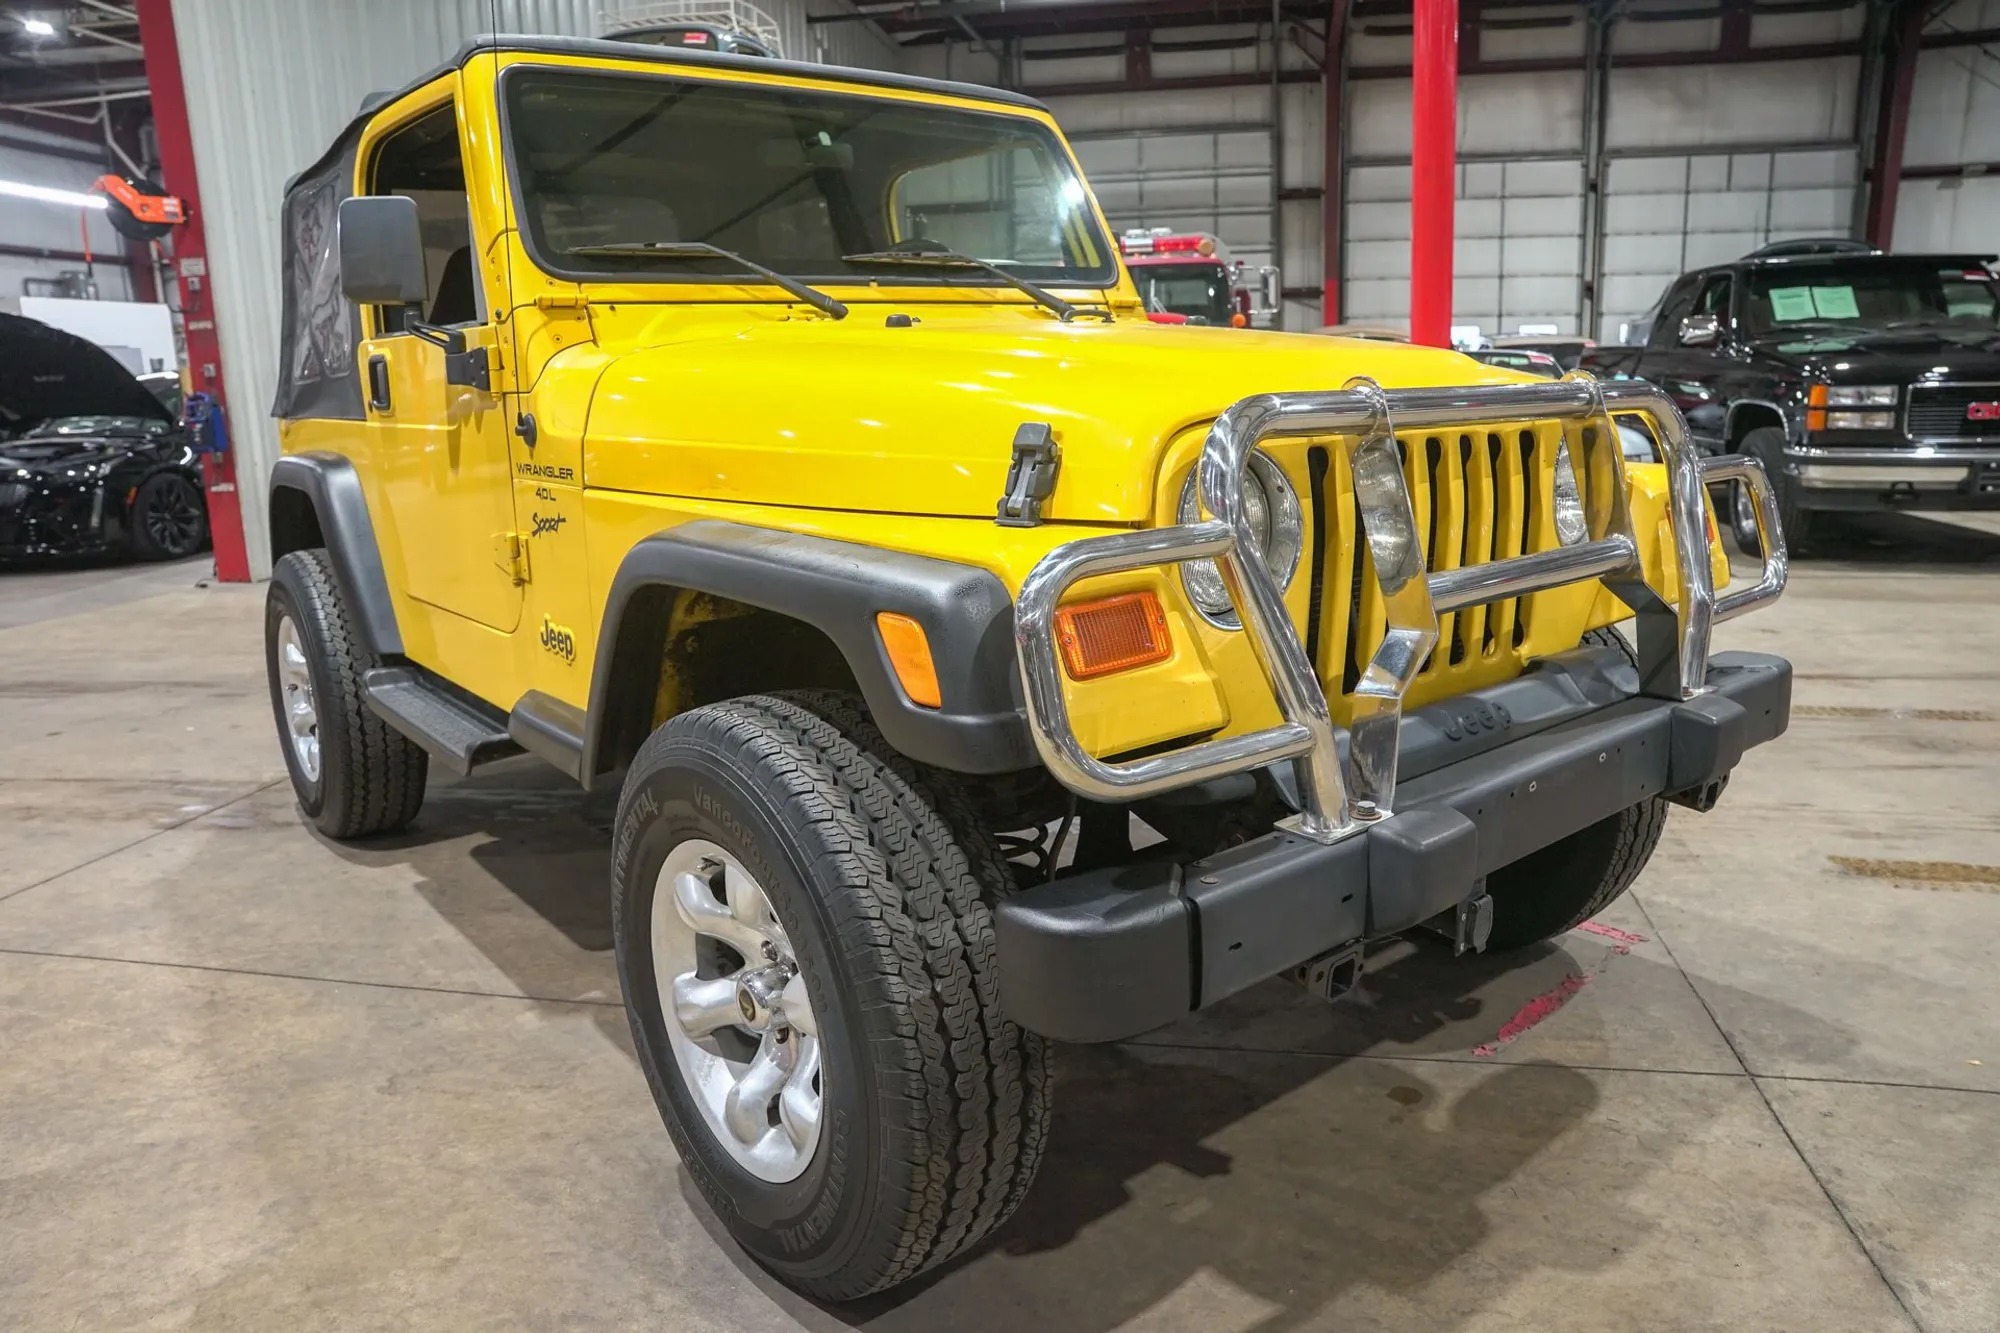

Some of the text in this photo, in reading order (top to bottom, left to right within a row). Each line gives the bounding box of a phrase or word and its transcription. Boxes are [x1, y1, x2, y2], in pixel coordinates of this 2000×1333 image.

[516, 463, 573, 480] WRANGLER
[532, 512, 567, 538] Sport
[540, 616, 575, 664] Jeep
